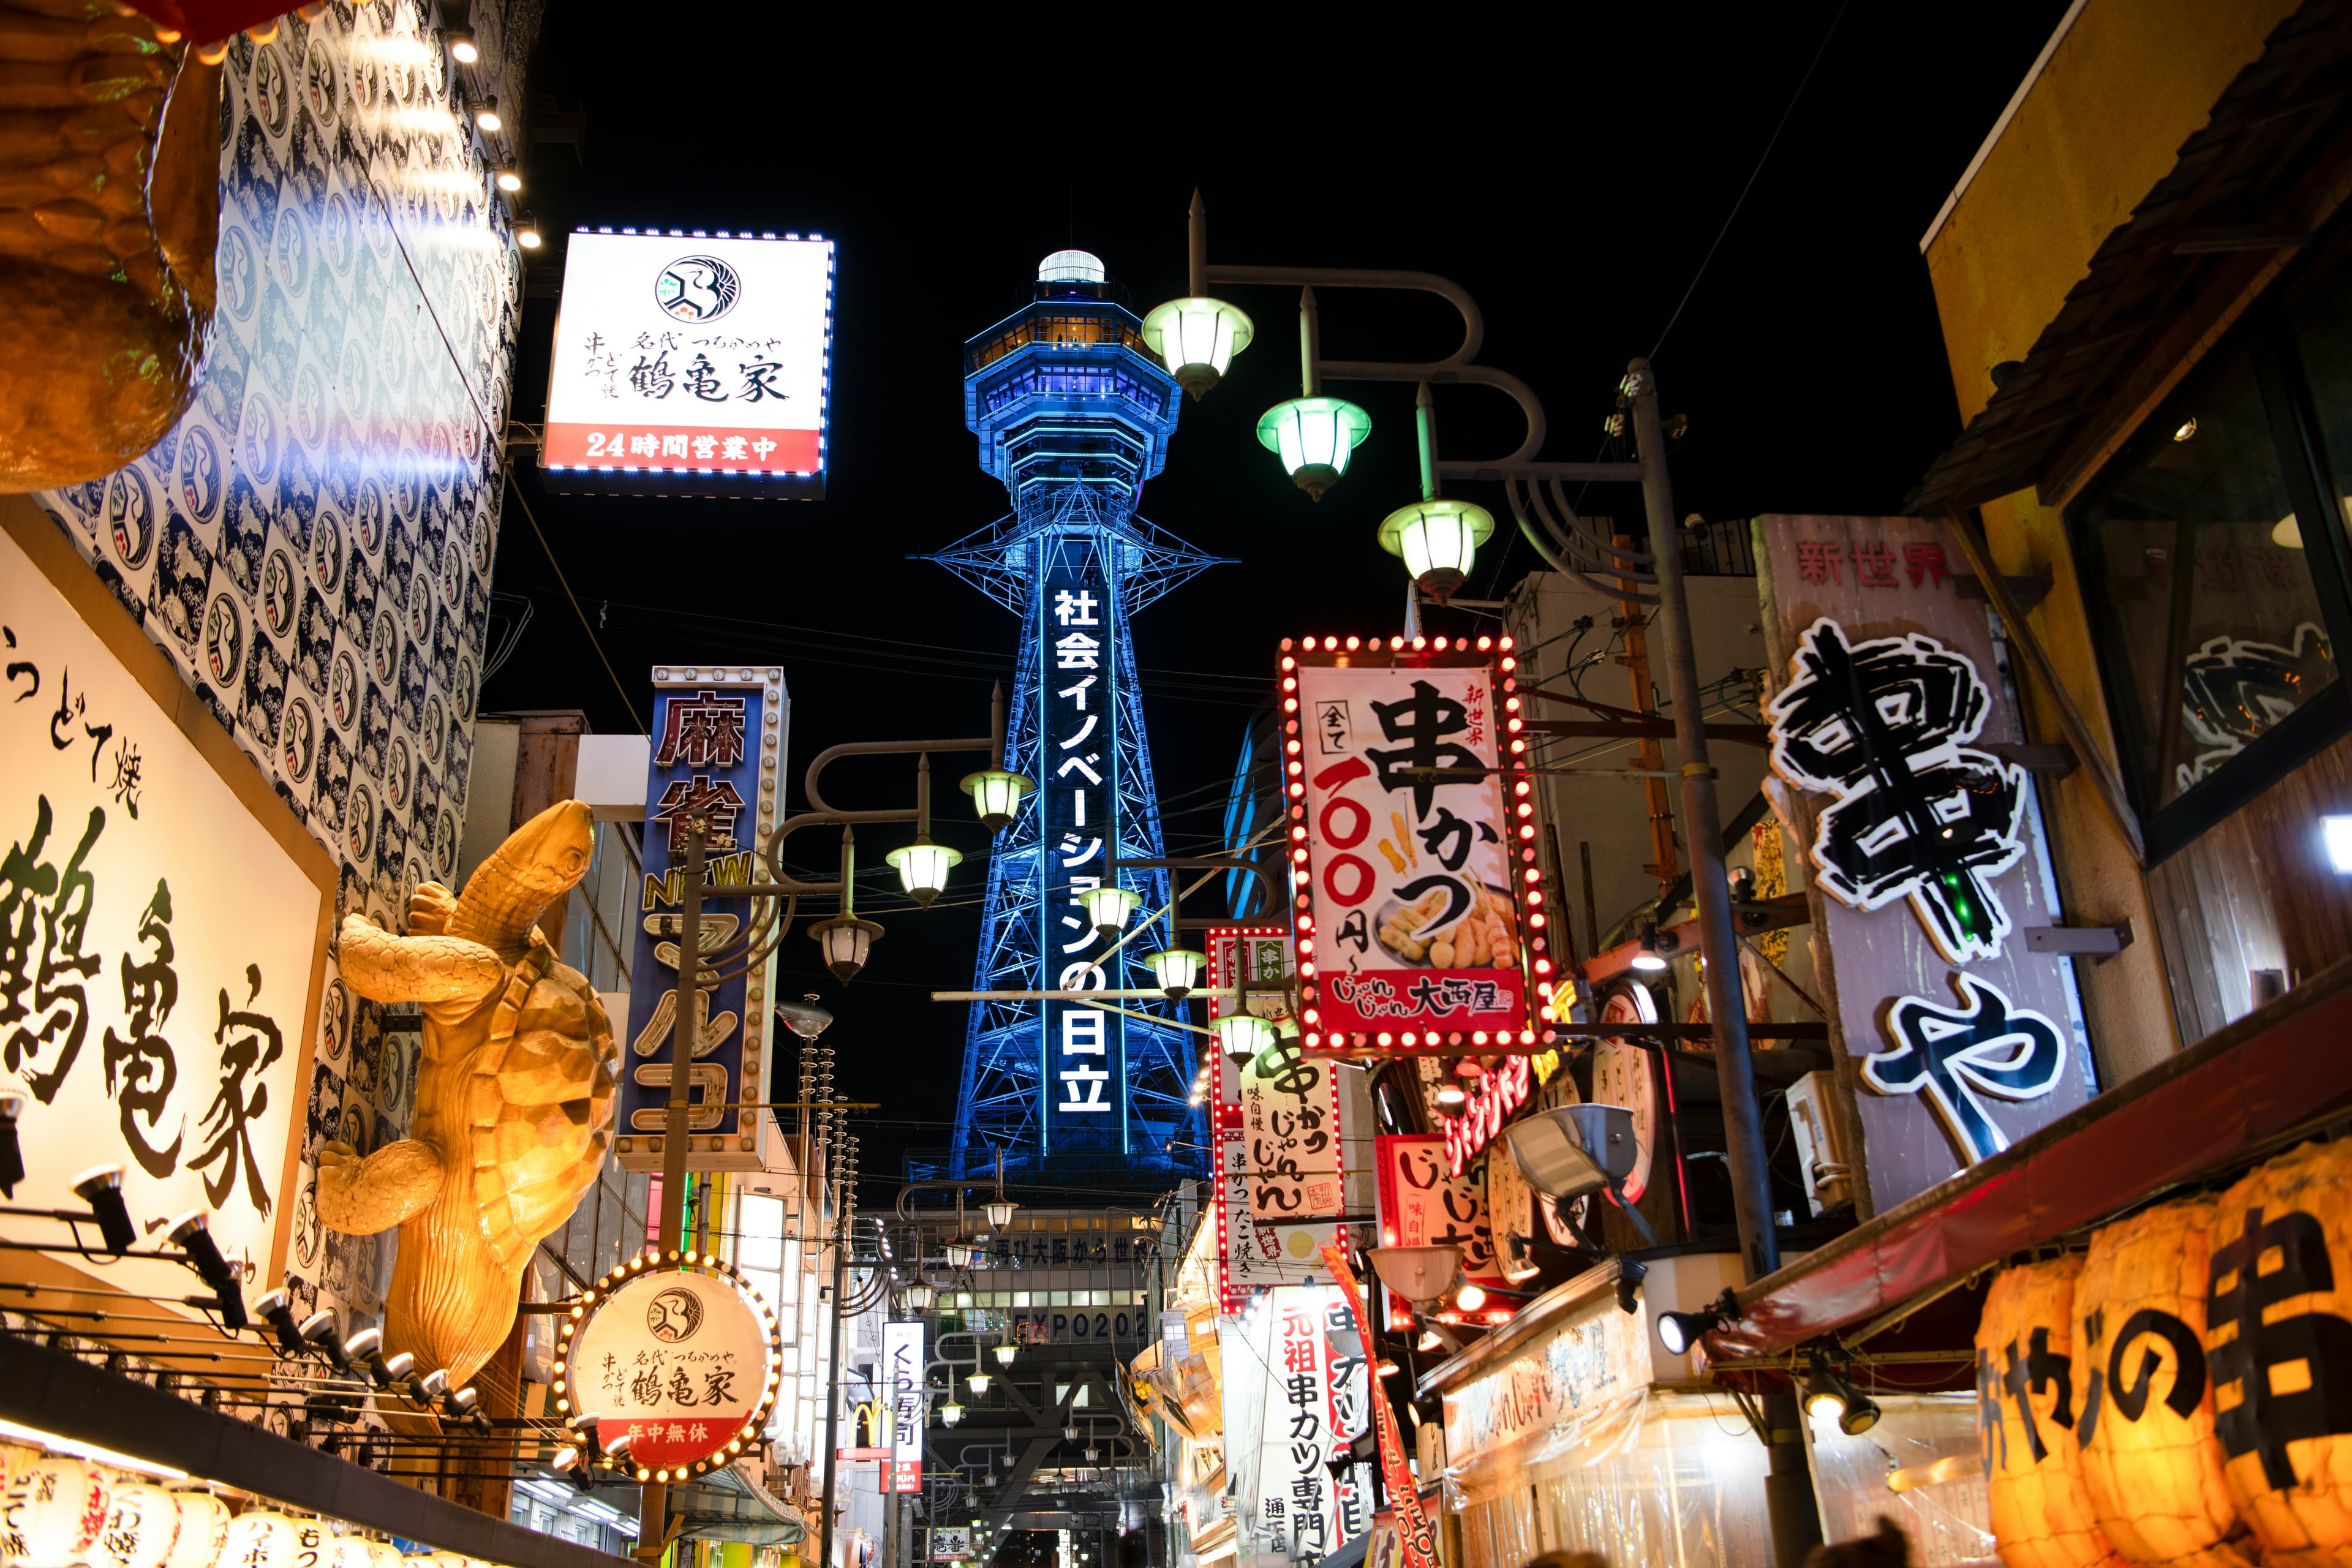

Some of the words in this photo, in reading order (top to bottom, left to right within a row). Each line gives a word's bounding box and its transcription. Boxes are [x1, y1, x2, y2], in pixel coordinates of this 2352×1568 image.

[584, 331, 605, 378] 串かつ
[600, 352, 622, 399] どて焼
[627, 350, 790, 403] 鶴亀家
[586, 432, 778, 462] 24時間営業中
[1798, 541, 1950, 587] 新世界
[1321, 706, 1346, 749] 全て
[1462, 684, 1484, 746] 新世界
[51, 665, 142, 820] どて焼
[650, 690, 745, 852] 麻雀
[1364, 679, 1498, 940] 串かつ
[1054, 590, 1110, 1112] 社会イノベーションの日立
[1261, 948, 1280, 981] 串か
[1409, 976, 1510, 1016] 大西屋
[631, 913, 740, 1131] マルコ
[1247, 1083, 1265, 1132] 味自慢
[1256, 1027, 1328, 1155] 串かつ
[1232, 1152, 1249, 1200] 串かつ
[1235, 1208, 1254, 1278] たこ焼き
[601, 1352, 617, 1391] 串かつ
[633, 1349, 668, 1365] 名代
[674, 1351, 735, 1365] つるかめや
[612, 1366, 627, 1407] どて焼
[629, 1365, 739, 1407] 鶴亀家
[627, 1423, 709, 1444] 年中無休
